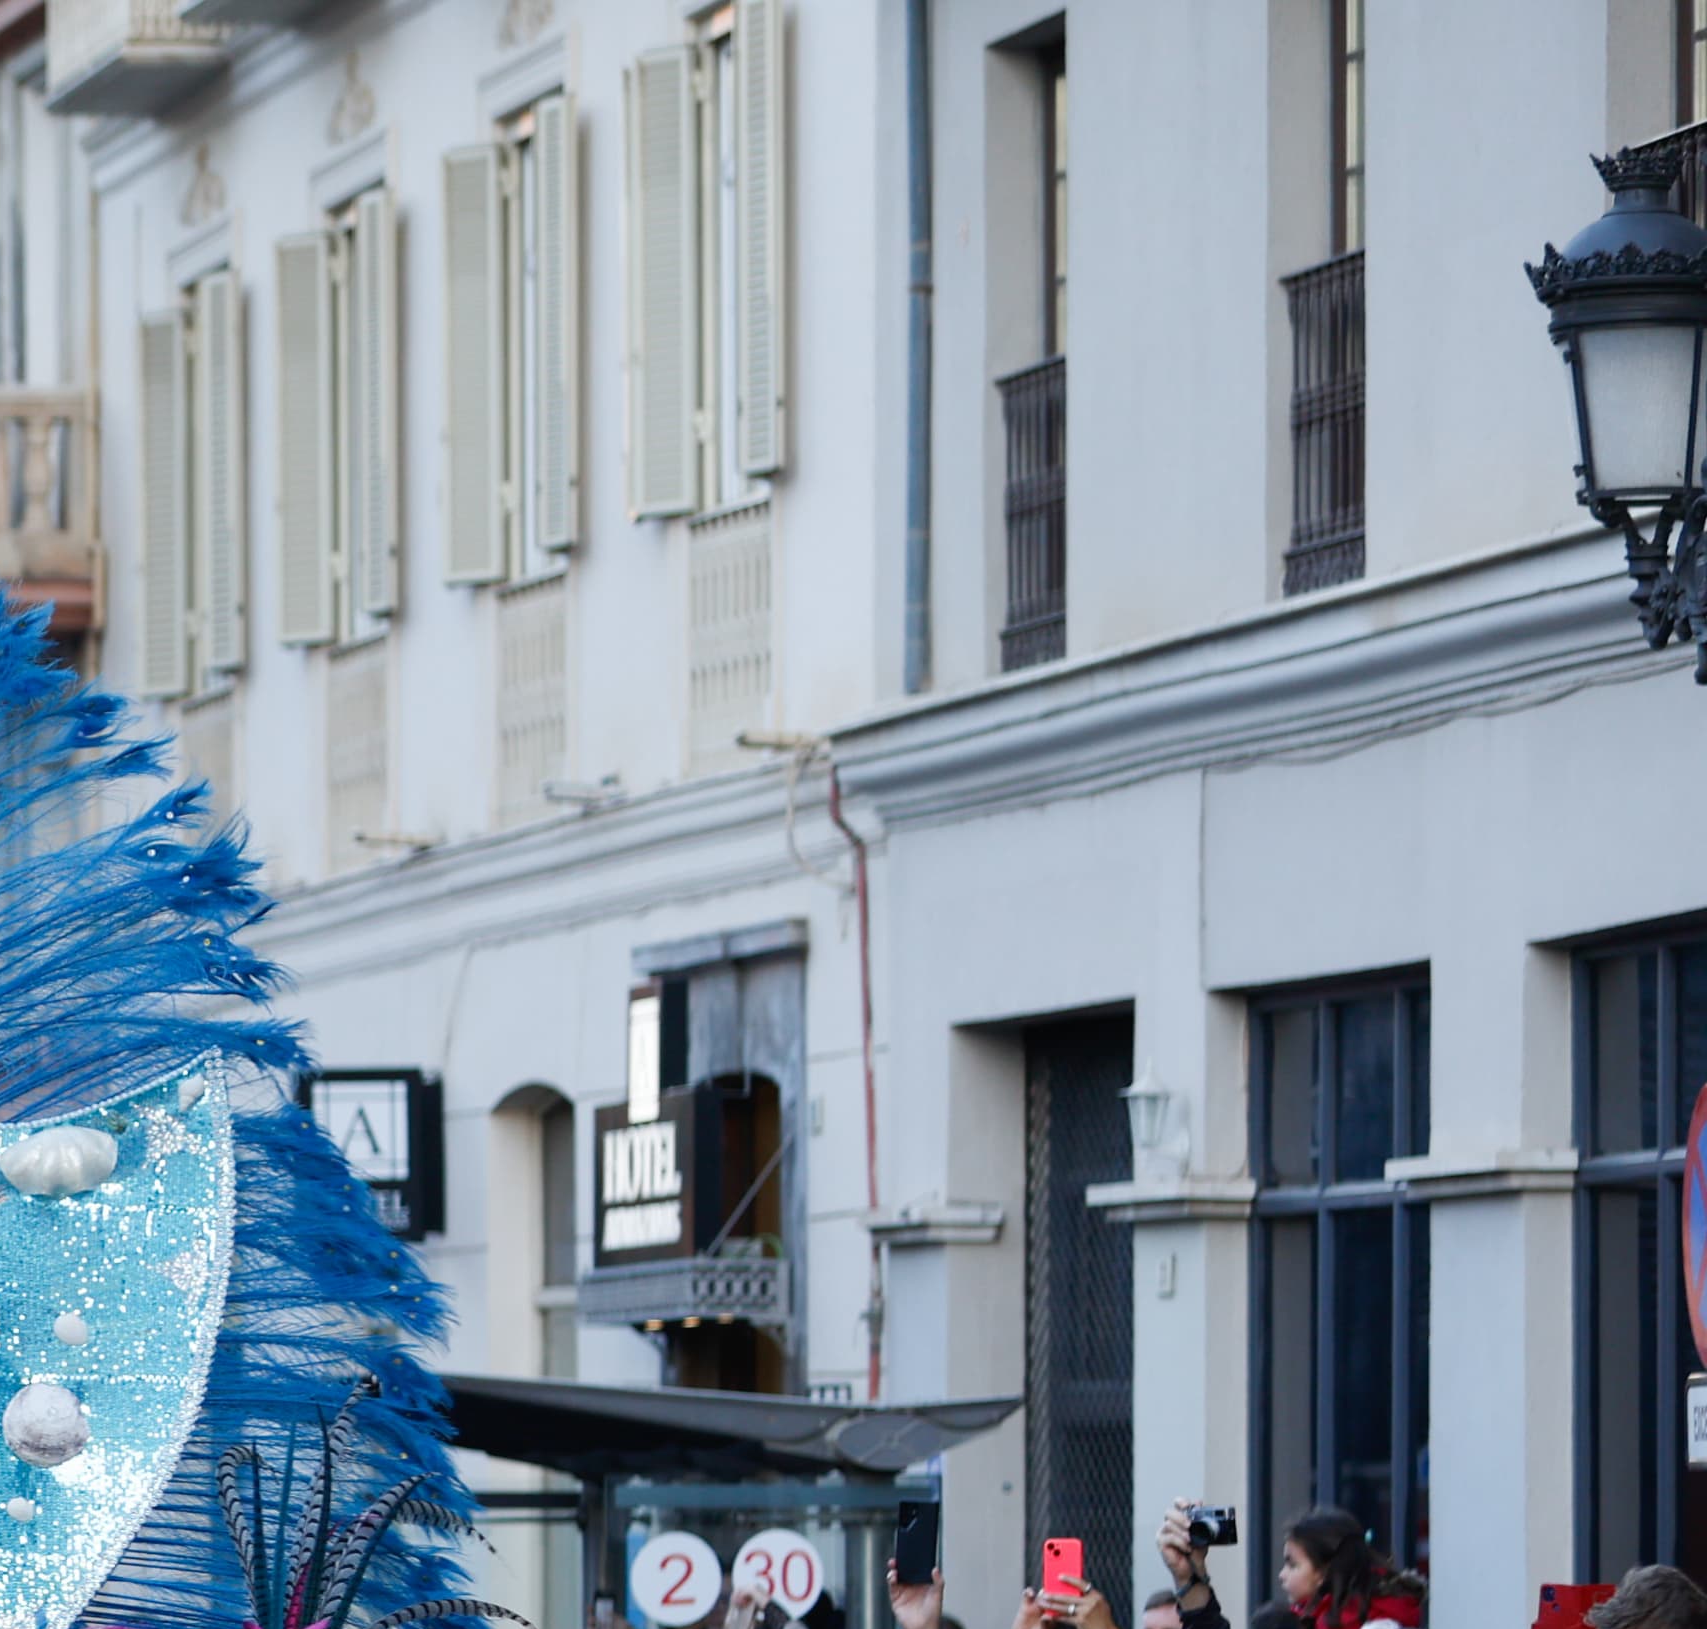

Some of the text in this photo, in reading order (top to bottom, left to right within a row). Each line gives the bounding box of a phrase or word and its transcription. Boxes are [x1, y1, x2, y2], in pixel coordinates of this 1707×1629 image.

[603, 1120, 682, 1204] HOTEL
[660, 1553, 696, 1605] 2
[745, 1549, 814, 1604] 30
